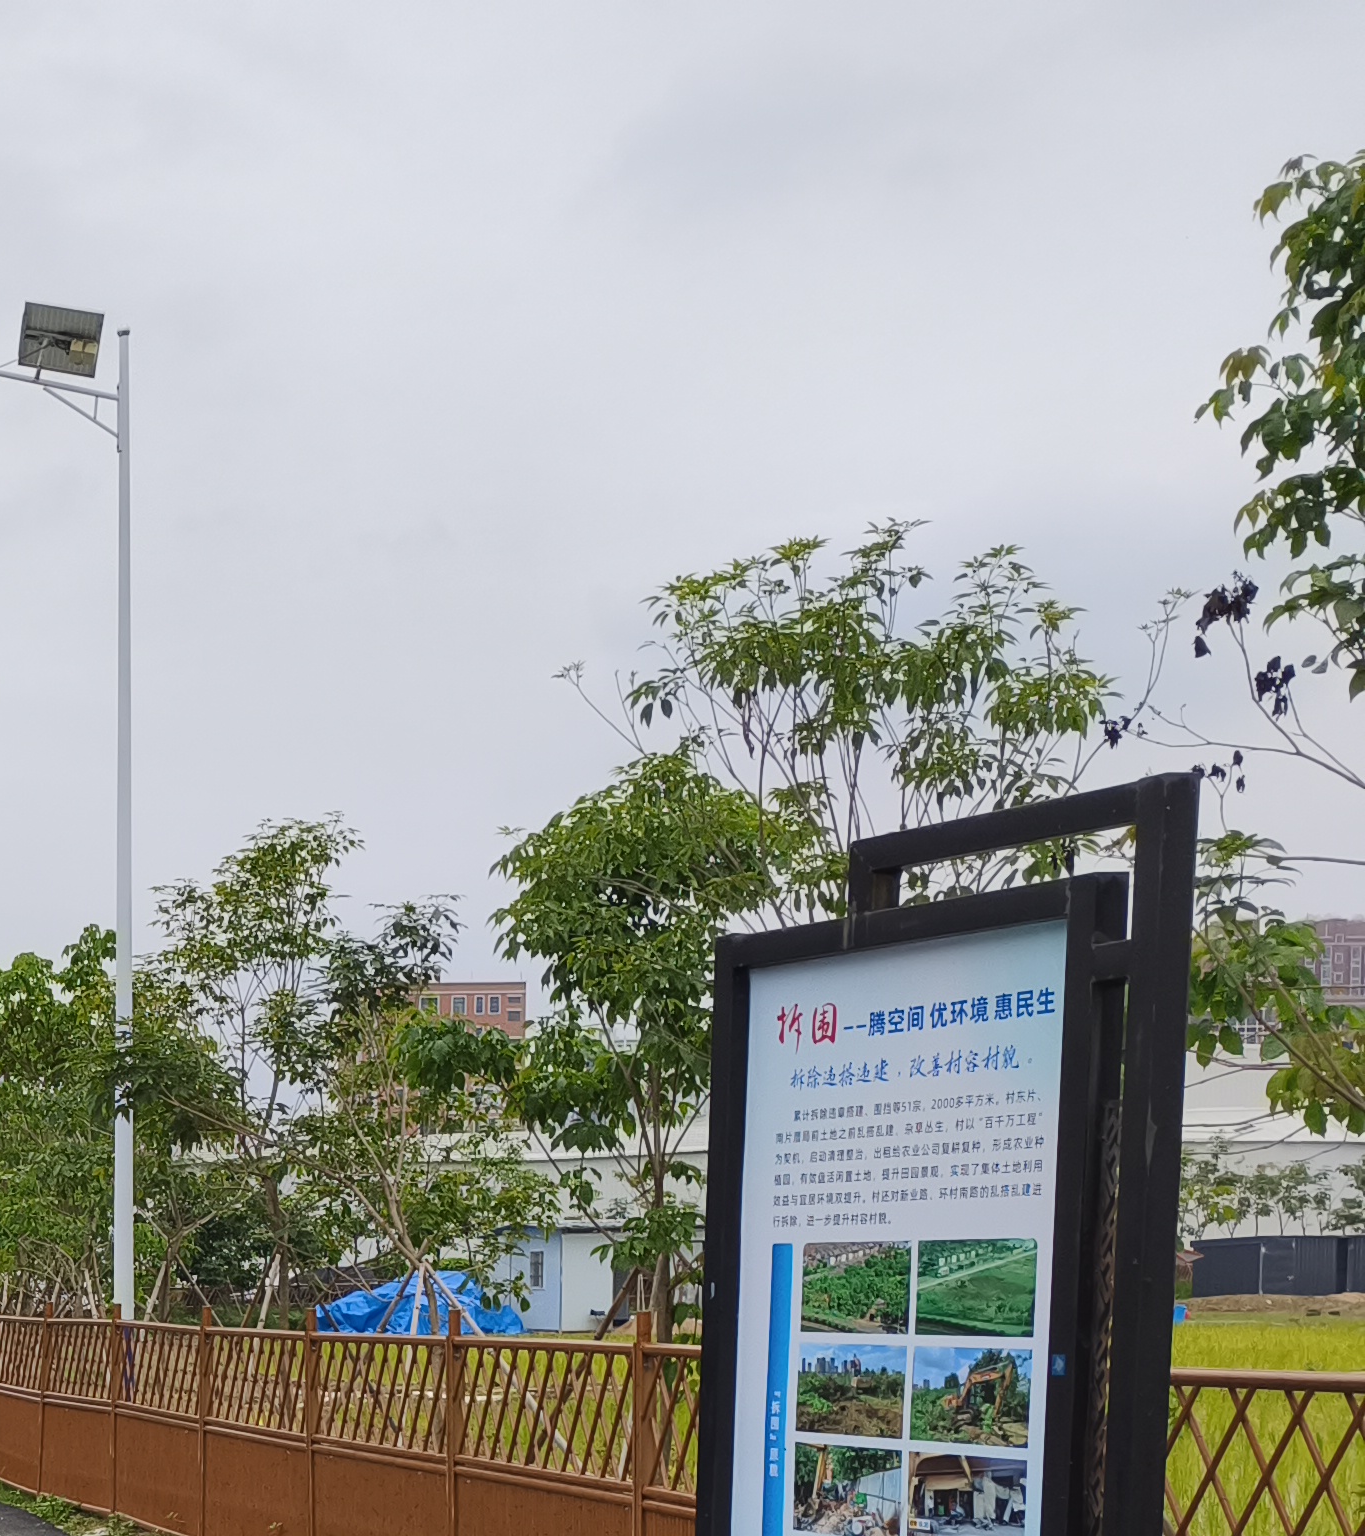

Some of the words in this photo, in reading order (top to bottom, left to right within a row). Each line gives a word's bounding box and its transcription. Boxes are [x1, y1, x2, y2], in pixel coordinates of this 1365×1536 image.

[930, 996, 989, 1030] 优环境
[994, 987, 1056, 1021] 惠民生
